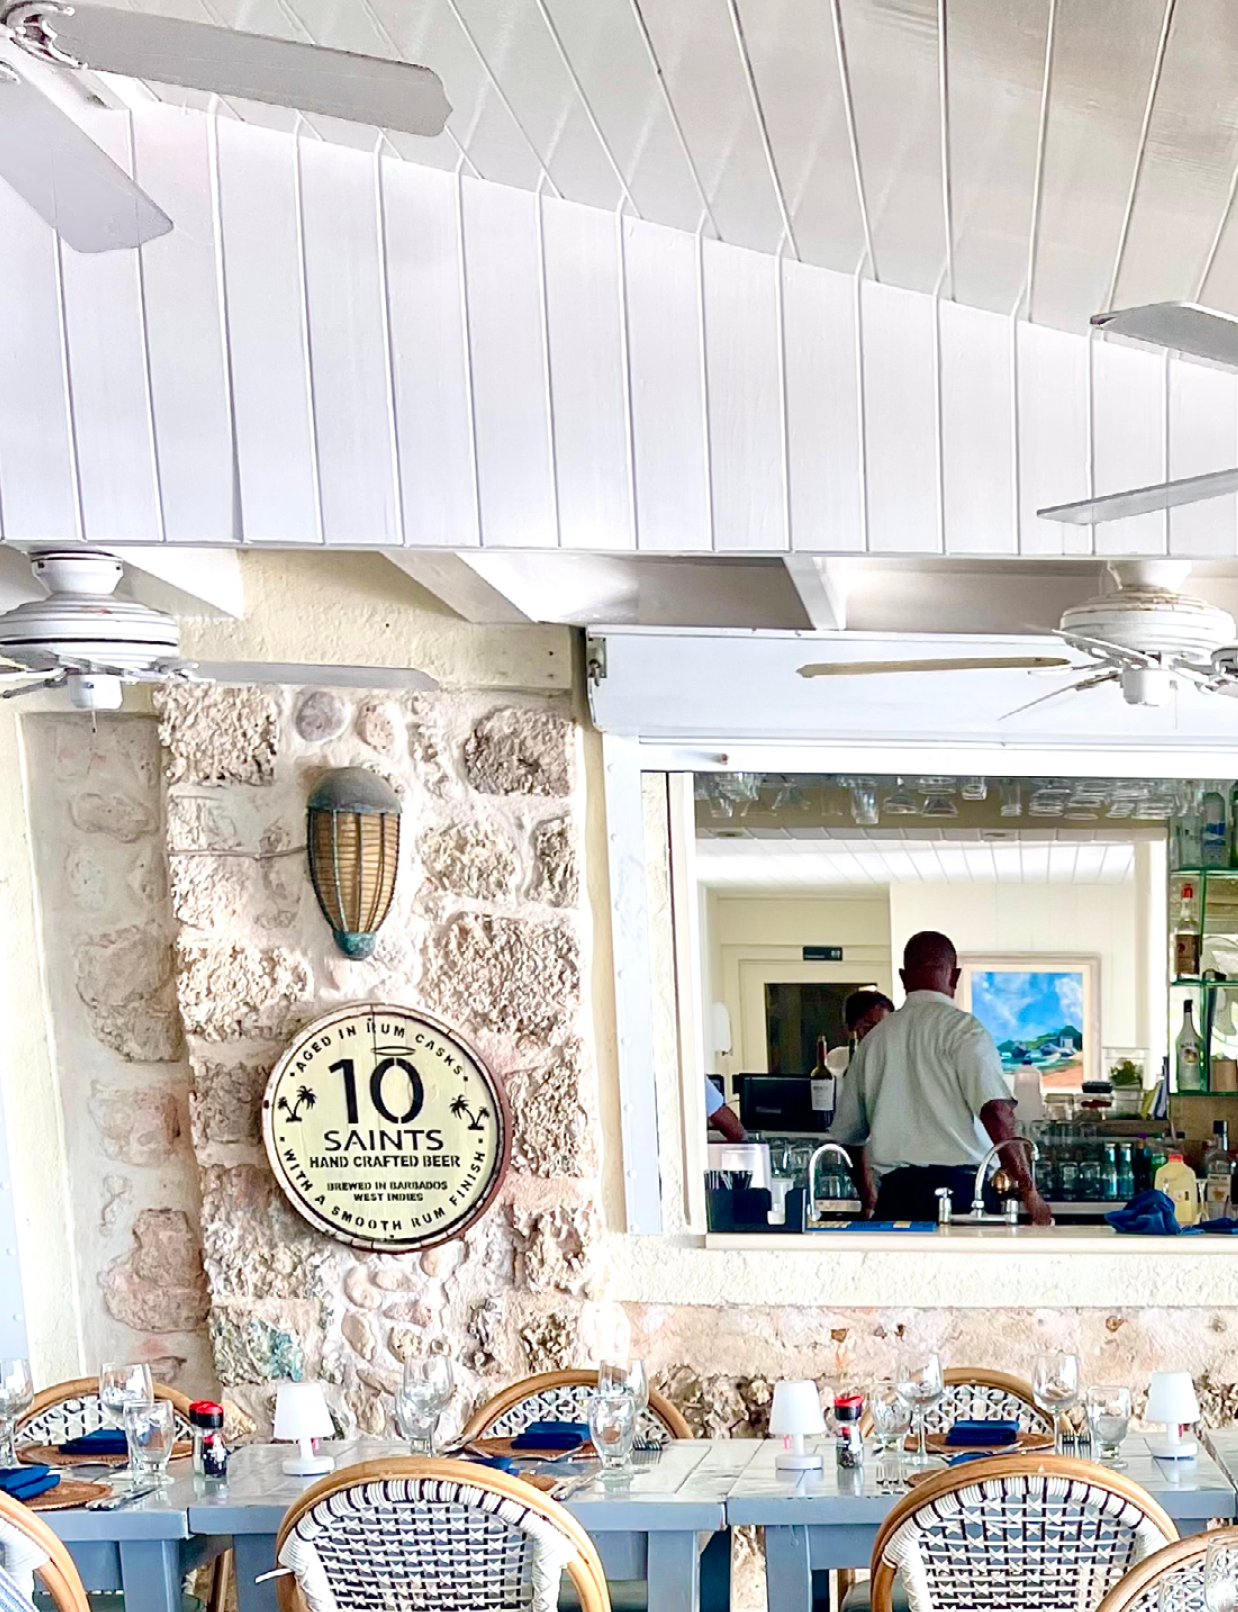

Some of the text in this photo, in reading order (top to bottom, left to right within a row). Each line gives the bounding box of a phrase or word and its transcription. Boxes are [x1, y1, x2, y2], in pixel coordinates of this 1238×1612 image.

[296, 1020, 463, 1075] AGED IN RUM CASKS
[328, 1057, 424, 1125] 10
[324, 1129, 444, 1151] SAINTS
[310, 1155, 460, 1168] HAND CRAFTED BEER
[284, 1148, 485, 1231] WITH A SMOOTH RUM FINISH
[327, 1181, 448, 1191] BREWED IN BARBADOS
[353, 1193, 423, 1201] WEST INDIES
